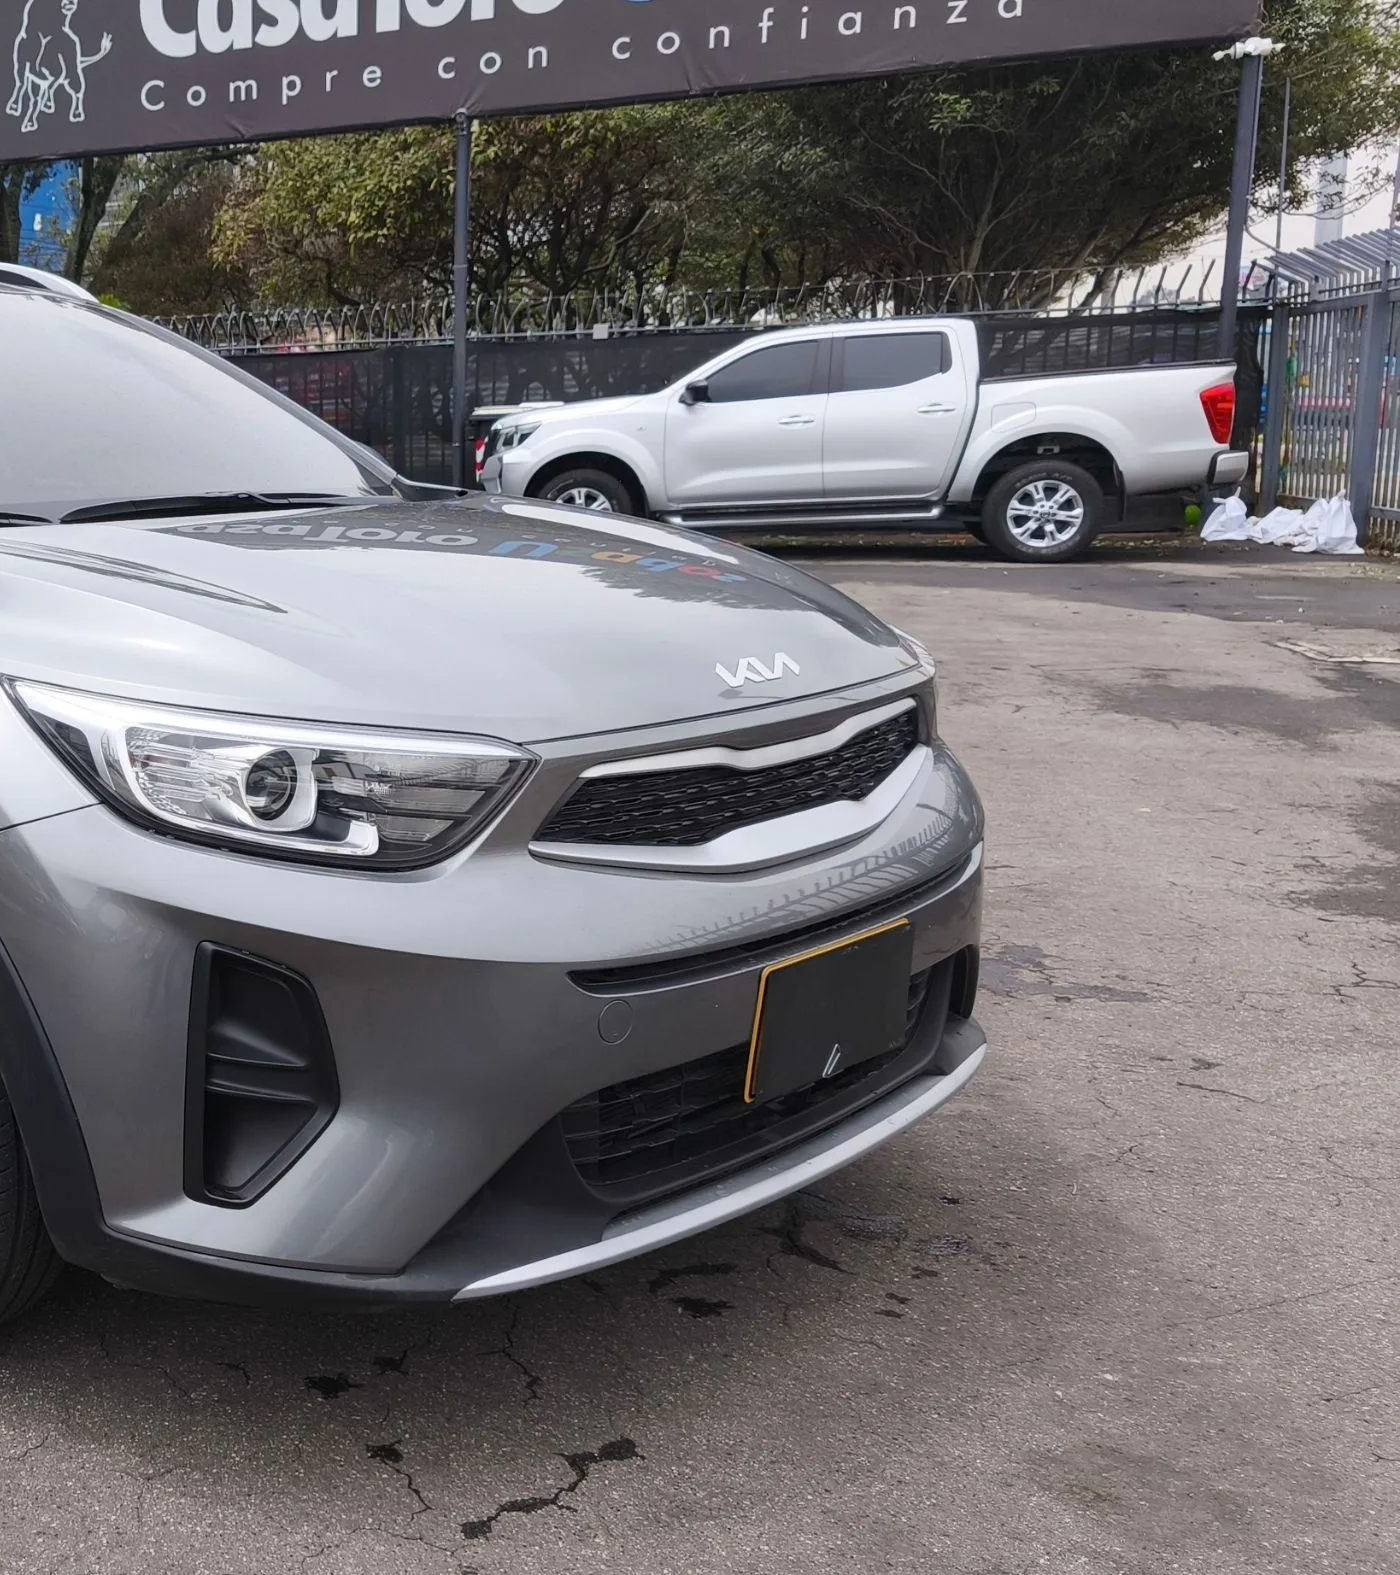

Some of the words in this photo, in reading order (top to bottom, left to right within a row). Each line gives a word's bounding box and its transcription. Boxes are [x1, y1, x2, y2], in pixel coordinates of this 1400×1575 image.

[139, 0, 566, 58] Casa
[140, 65, 382, 111] Compre
[437, 45, 549, 79] con
[611, 0, 1023, 60] confianza
